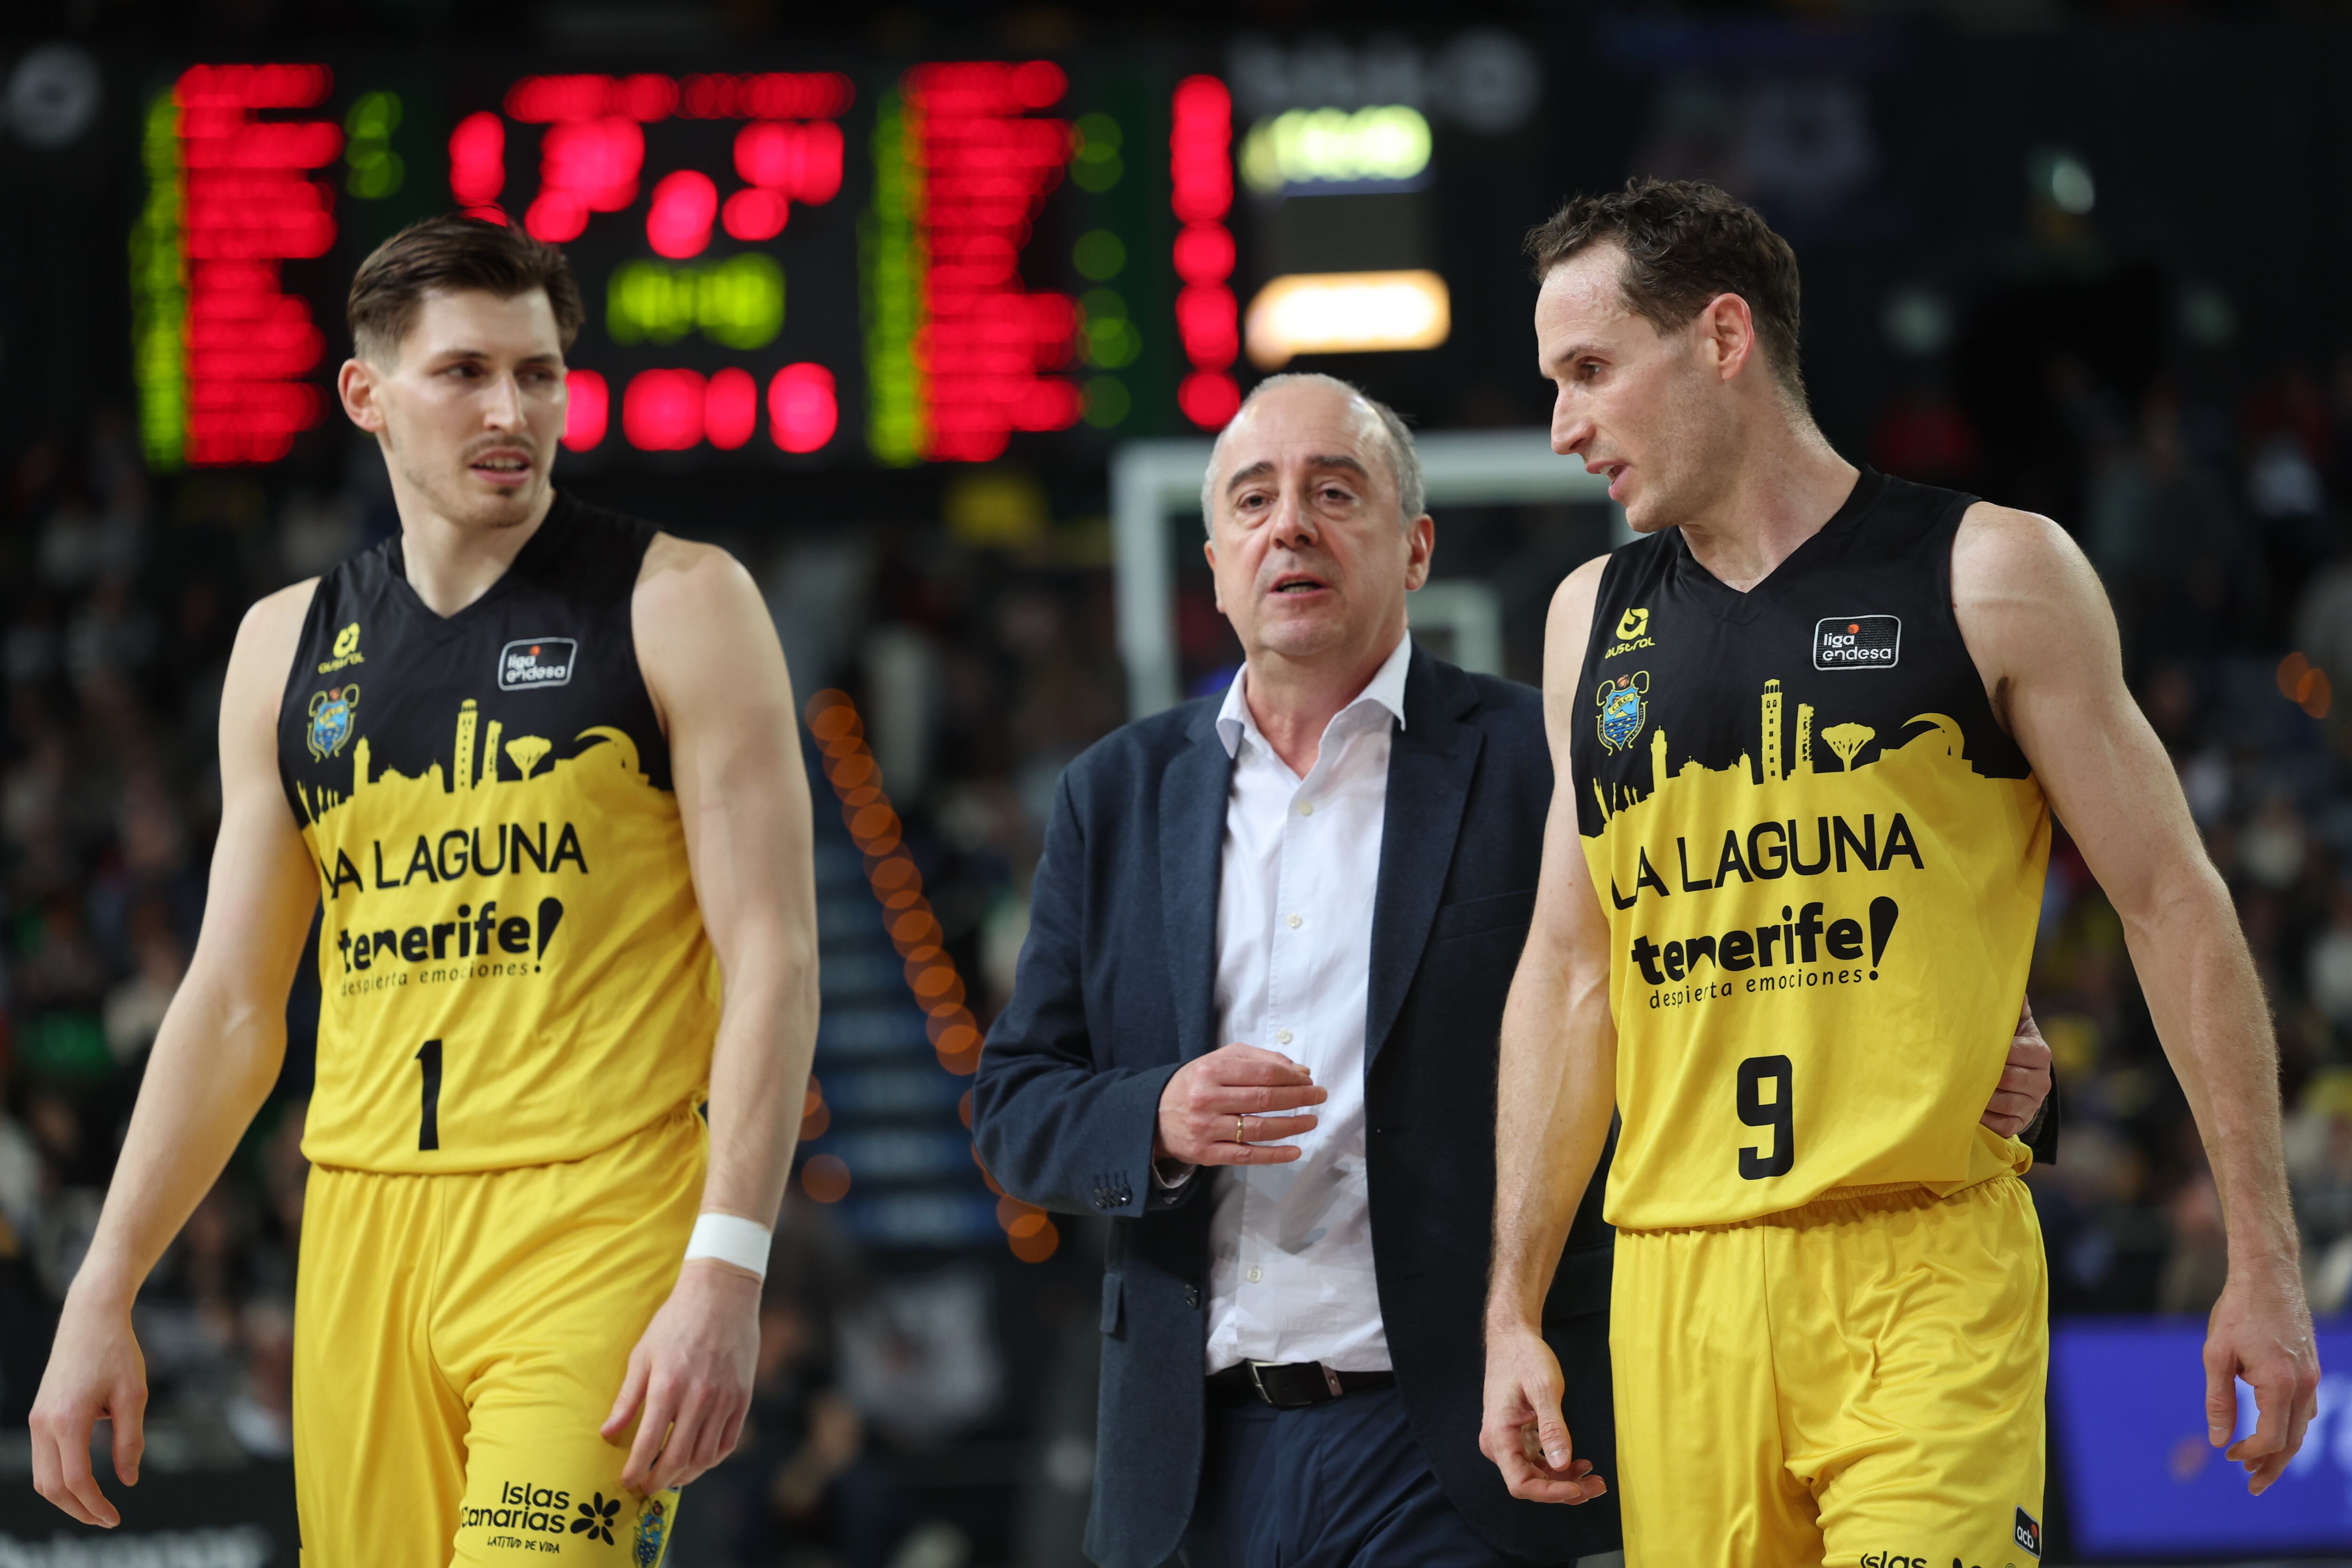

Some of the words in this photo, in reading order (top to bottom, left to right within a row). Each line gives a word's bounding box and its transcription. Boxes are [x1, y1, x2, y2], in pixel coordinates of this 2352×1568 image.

[1605, 637, 1655, 659] austral
[1822, 646, 1892, 661] endesa
[1823, 633, 1855, 648] liga
[506, 664, 566, 683] endesa
[507, 653, 537, 670] liga
[373, 821, 588, 889] LAGUNA
[1612, 845, 1670, 910] LA
[1677, 812, 1925, 892] LAGUNA
[341, 971, 408, 997] despierta
[419, 961, 528, 984] emociones
[1649, 981, 1732, 1010] despierta
[1746, 969, 1862, 993] emociones
[414, 1038, 443, 1151] 1
[1736, 1054, 1795, 1180] 9
[501, 1481, 570, 1509] Islas
[487, 1536, 522, 1549] LATITUD
[525, 1539, 537, 1550] DE
[539, 1541, 560, 1554] VIDA
[2017, 1525, 2034, 1549] acb
